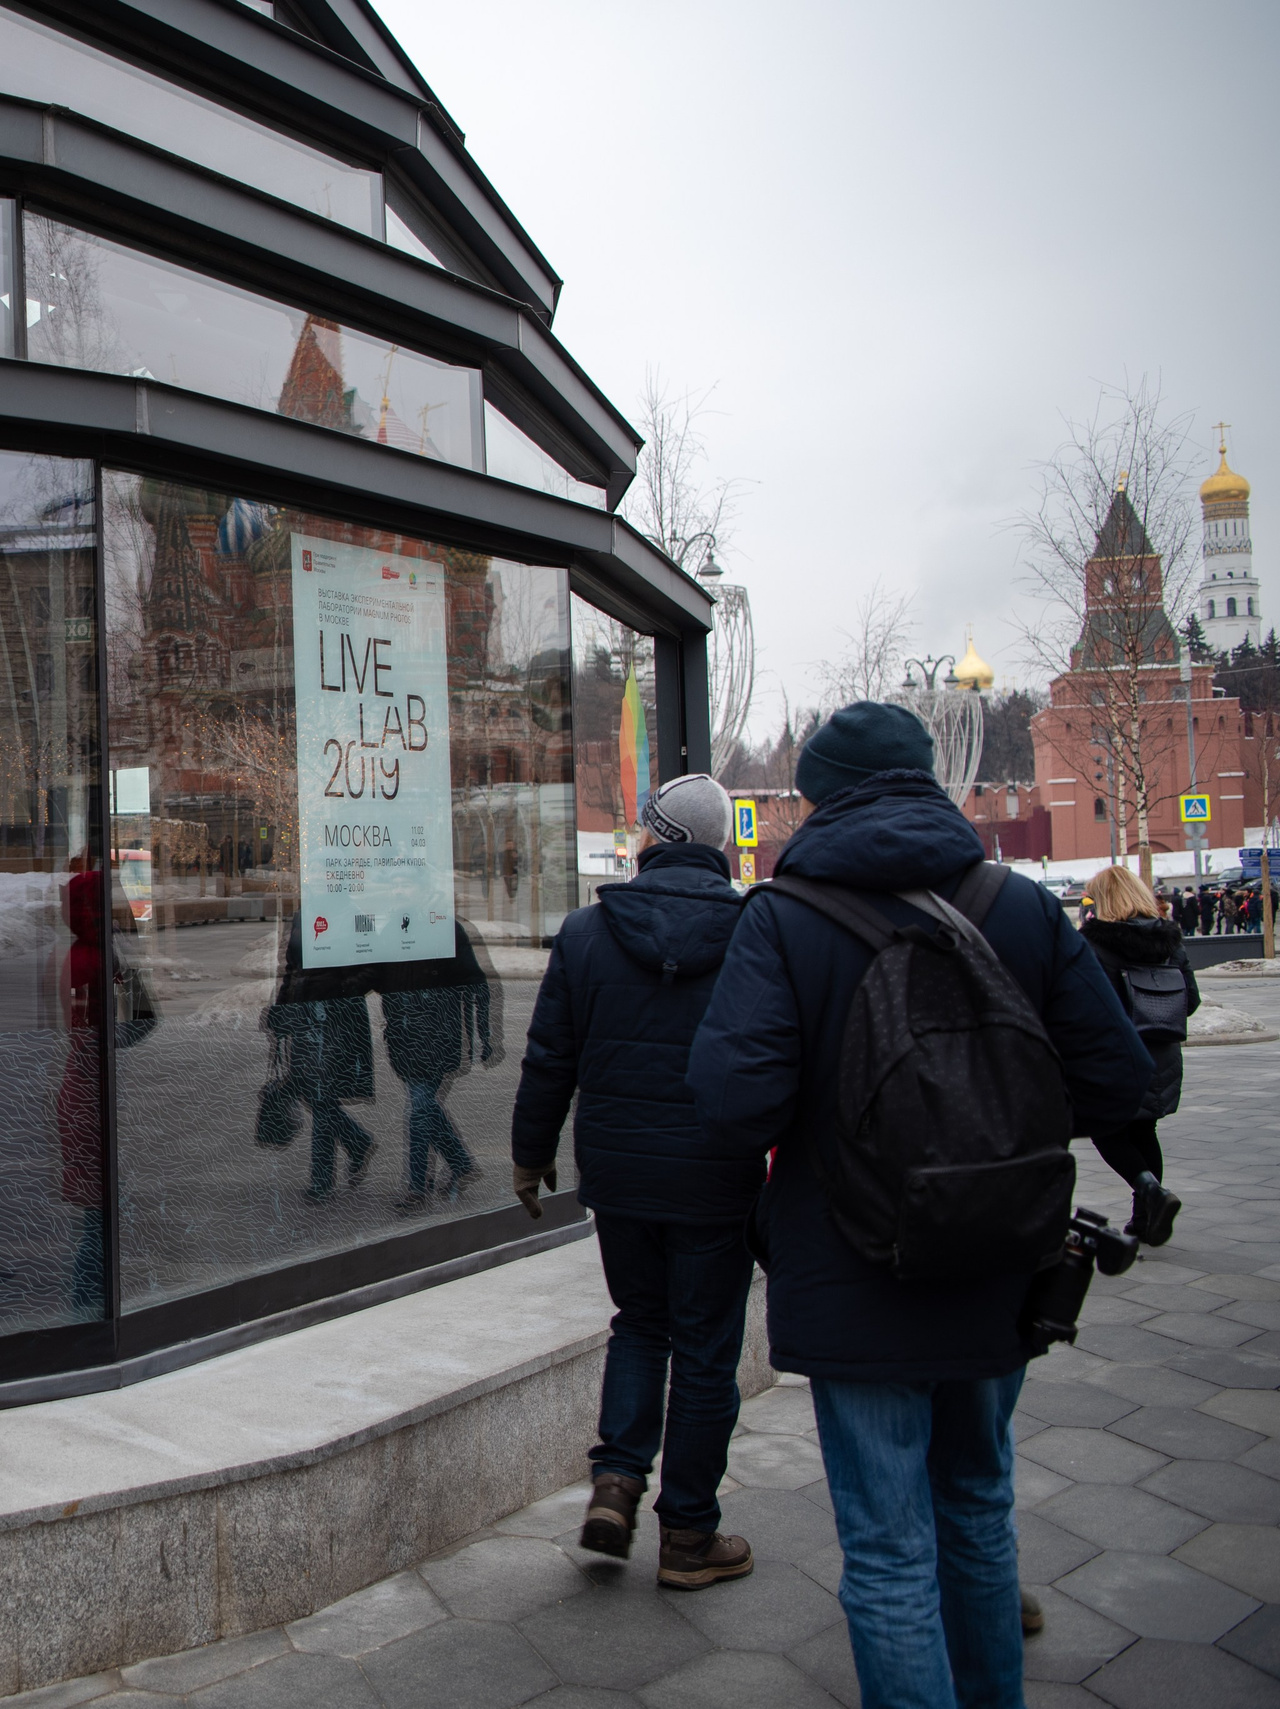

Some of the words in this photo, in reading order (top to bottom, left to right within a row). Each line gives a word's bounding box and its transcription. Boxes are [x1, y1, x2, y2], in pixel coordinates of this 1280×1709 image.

[318, 588, 350, 602] ВЫСТАВКА
[350, 593, 414, 613] ЭКСПЕРИМЕНТАЛЬНОЙ
[318, 600, 362, 616] ЛАБОРАТОРИИ
[362, 609, 389, 621] MAGNUM
[390, 613, 411, 625] PHOTOS
[319, 613, 324, 623] В
[324, 614, 350, 627] МОСКВЕ
[320, 629, 394, 698] LIVE
[359, 693, 428, 752] LAB
[323, 738, 400, 801] 2019
[324, 824, 392, 847] МОСКВА
[325, 858, 342, 867] ПАРК
[374, 857, 406, 867] ПАВИЛЬОН
[407, 857, 426, 867] КУПОЛ
[326, 870, 365, 881] ЕЖЕДНЕВНО
